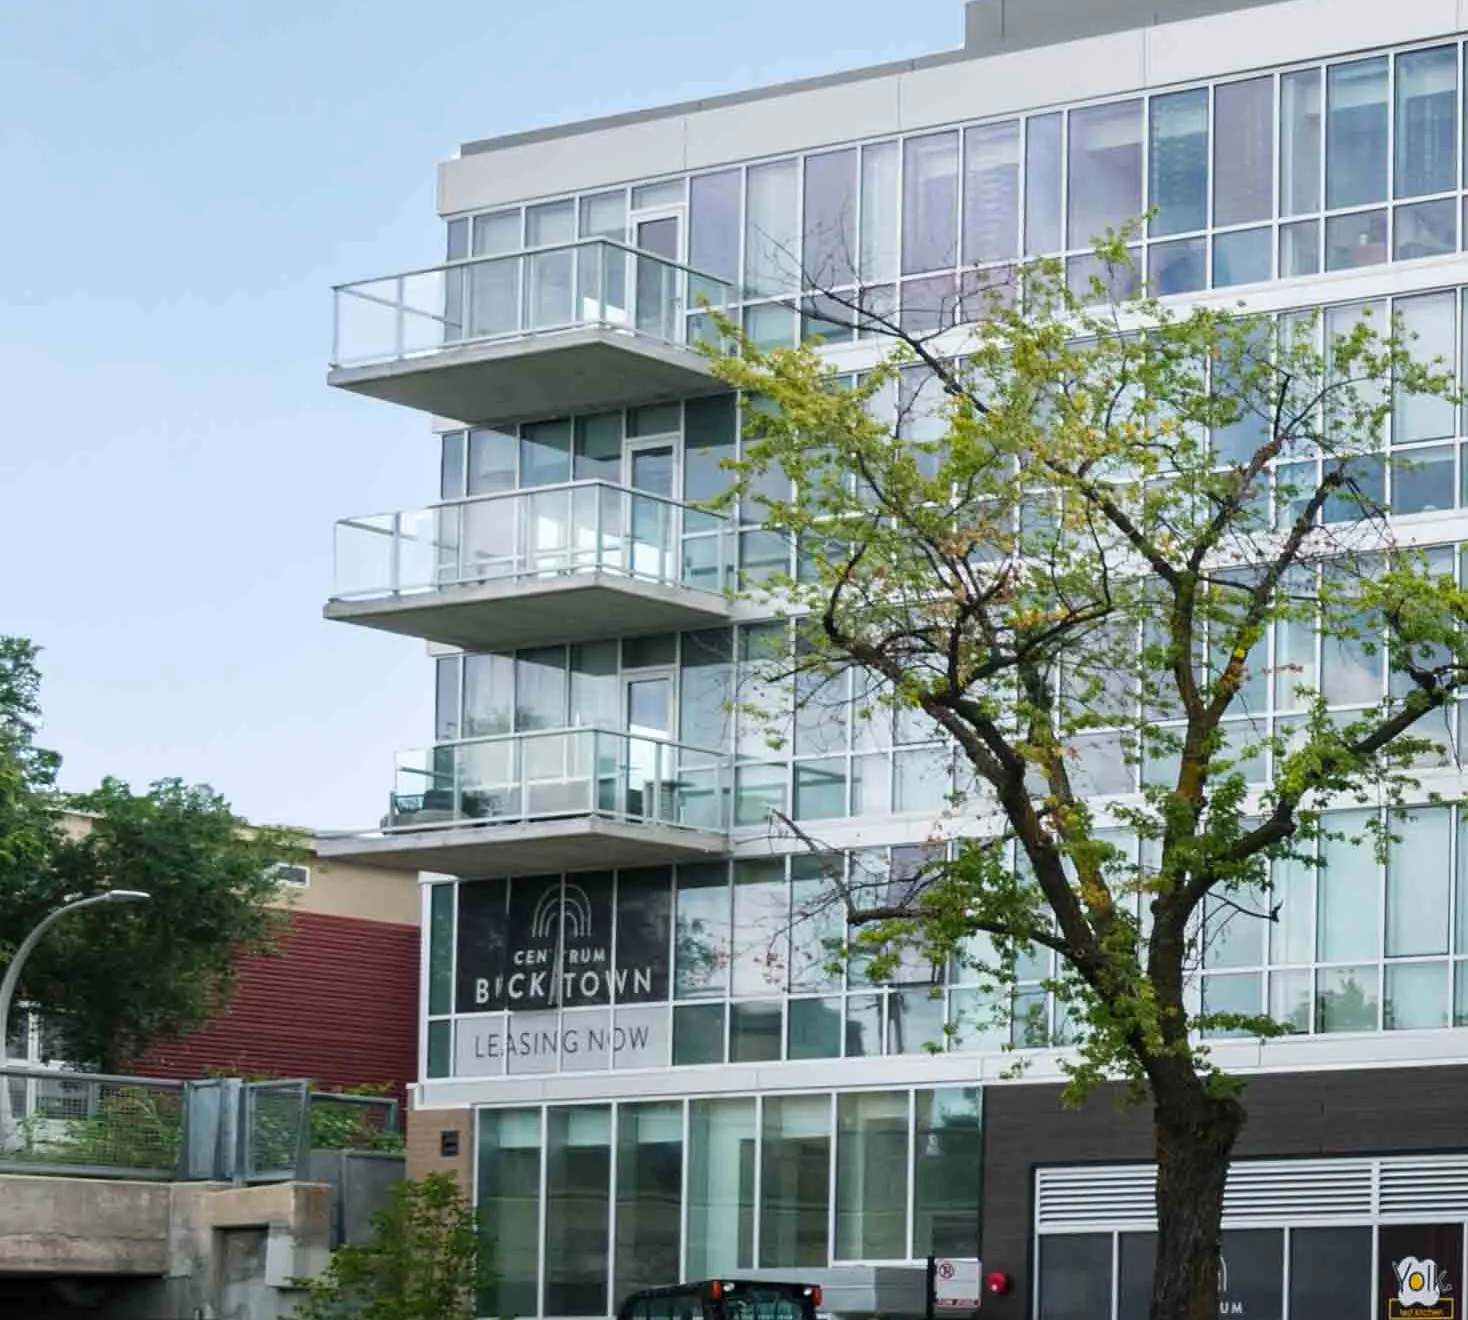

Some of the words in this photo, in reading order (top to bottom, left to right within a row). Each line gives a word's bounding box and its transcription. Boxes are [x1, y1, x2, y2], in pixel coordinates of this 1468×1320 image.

[513, 947, 605, 965] CENRUM
[475, 1030, 578, 1058] LEASING
[588, 1027, 649, 1052] NOW
